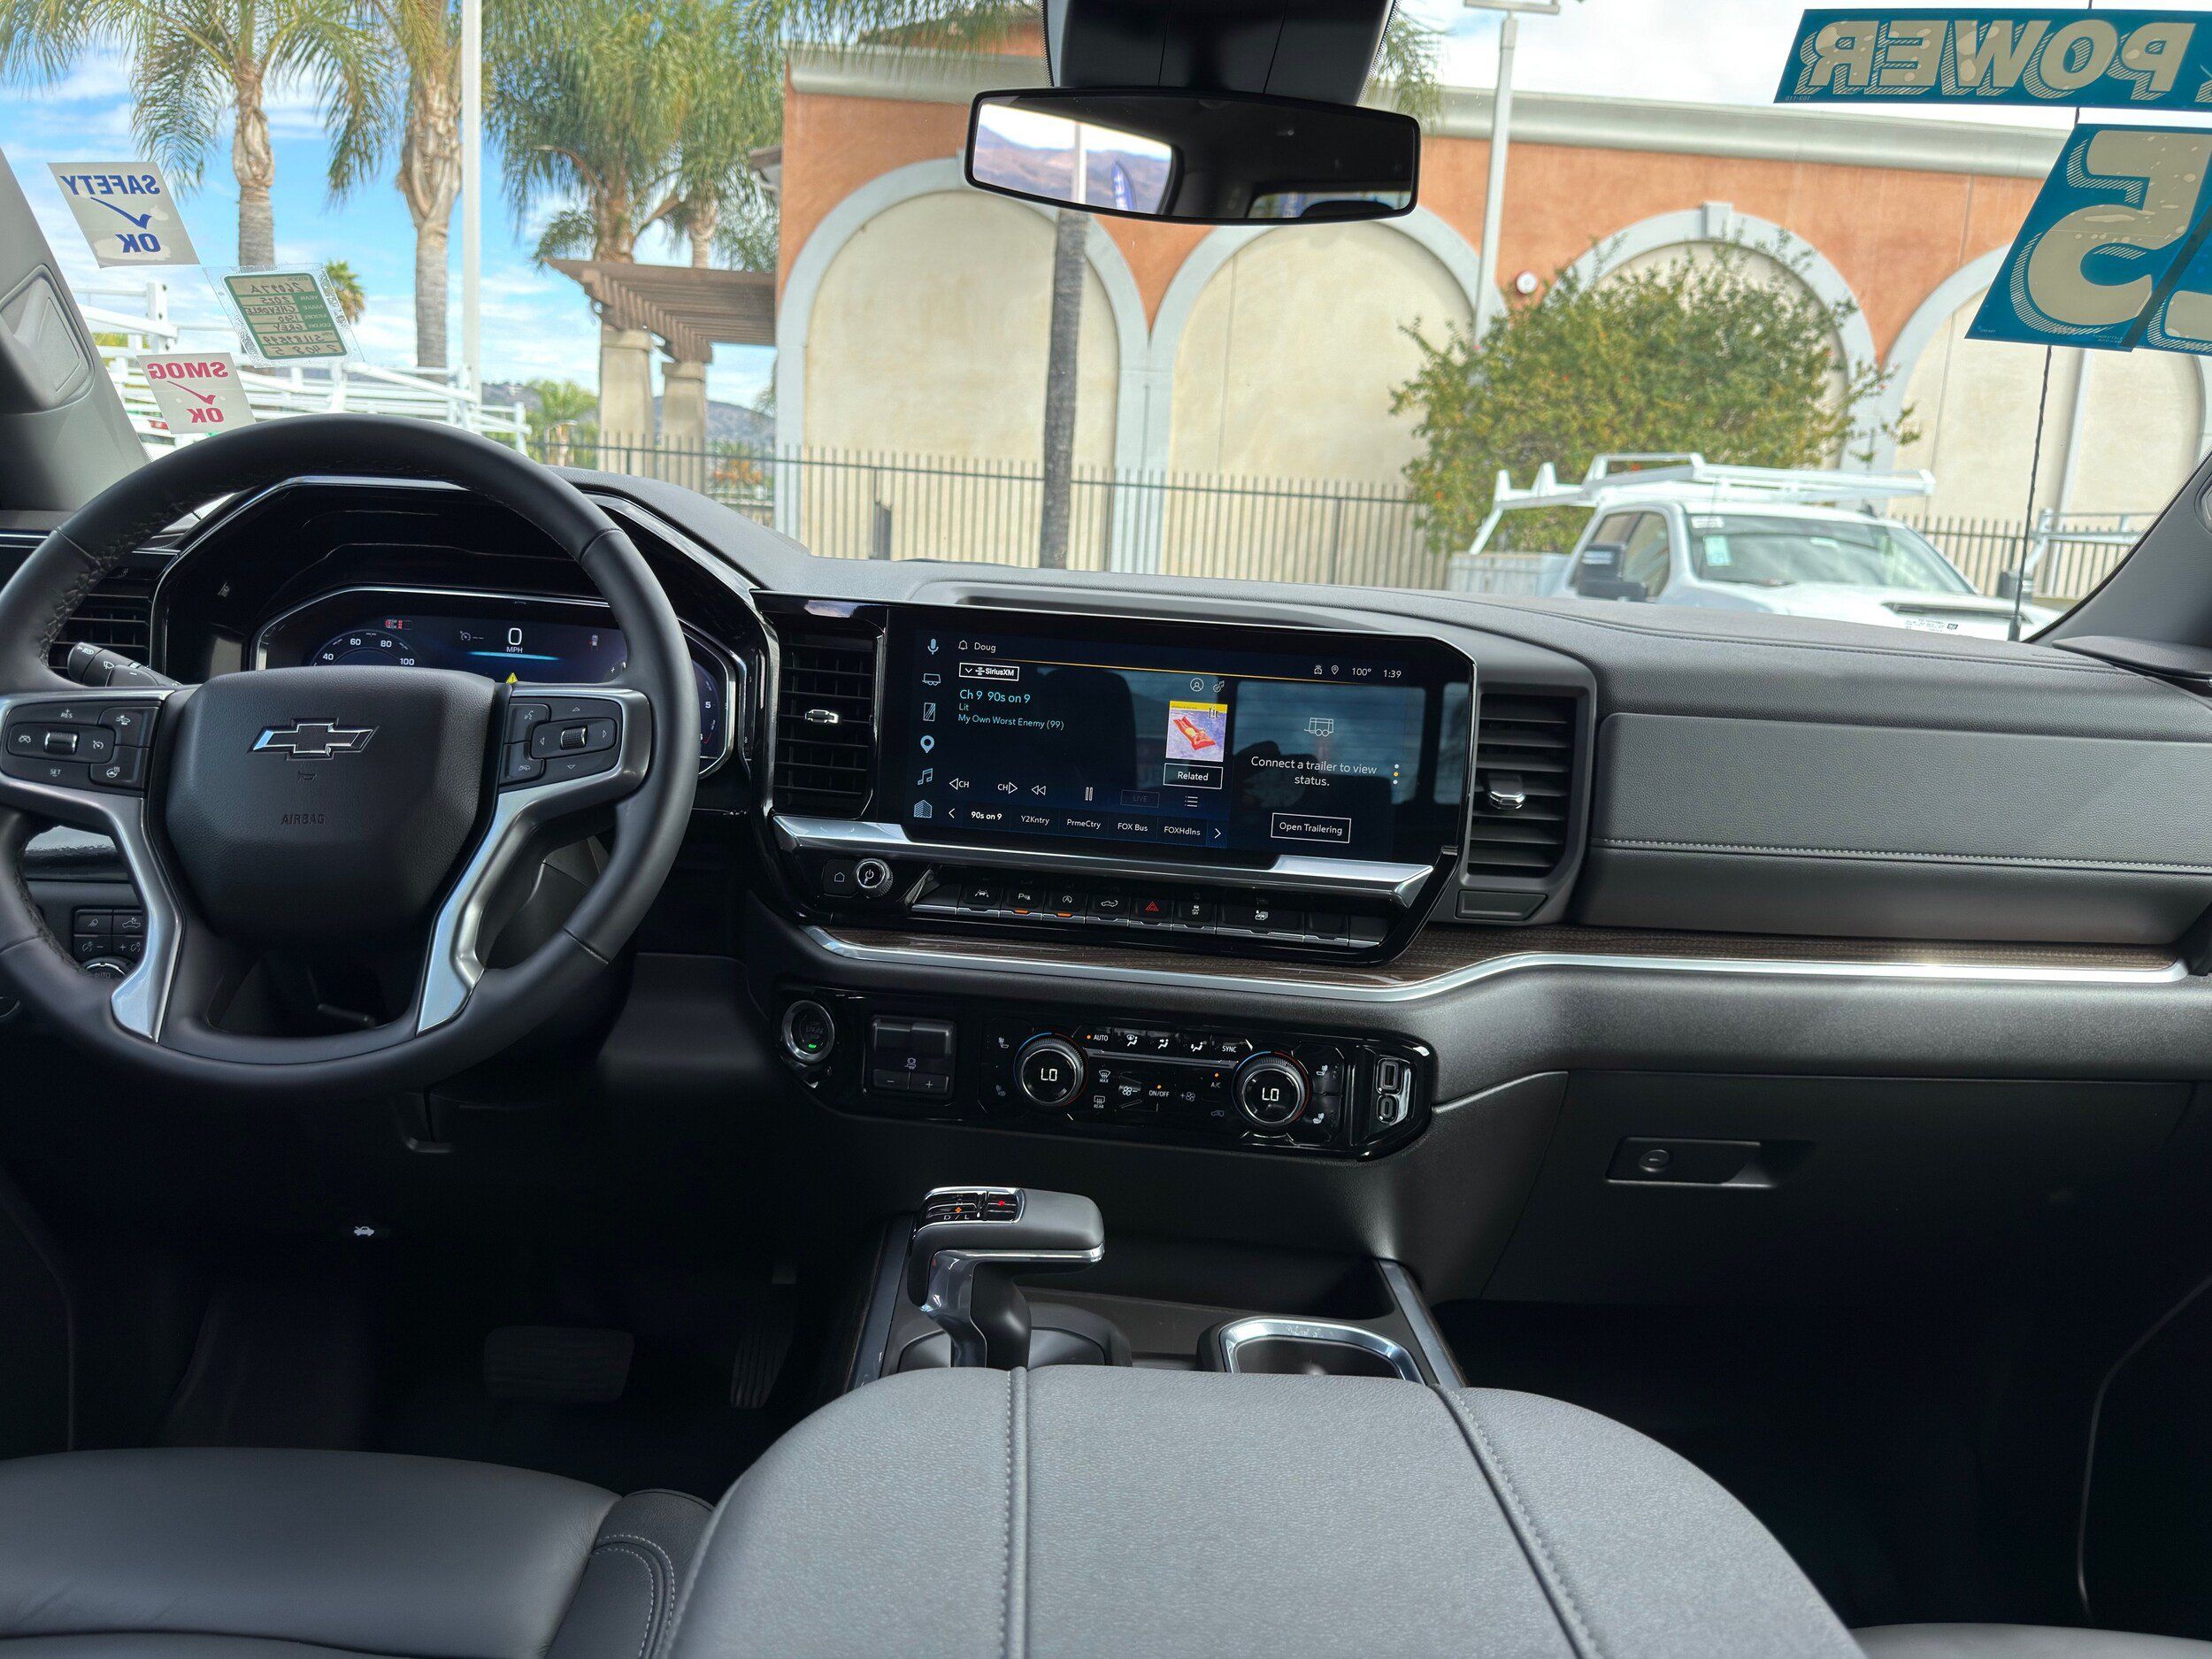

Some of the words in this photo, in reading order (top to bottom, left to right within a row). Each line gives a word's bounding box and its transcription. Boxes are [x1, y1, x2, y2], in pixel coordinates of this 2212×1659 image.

[508, 627, 522, 645] 0
[974, 642, 996, 653] Doug
[985, 668, 1015, 677] SiriusXM
[1383, 668, 1402, 679] 1:39
[959, 689, 973, 700] Ch
[976, 690, 983, 700] 9
[987, 691, 1006, 702] 90s
[1008, 695, 1022, 703] on
[1024, 694, 1031, 703] 9
[958, 714, 971, 724] My
[972, 715, 990, 724] Own
[992, 716, 1016, 726] Worst
[1018, 718, 1045, 729] Enemy
[1046, 720, 1064, 731] (99)
[1251, 756, 1295, 769] Connect
[1297, 761, 1303, 770] a
[1306, 761, 1338, 772] trailer
[1340, 764, 1350, 773] to
[1353, 764, 1378, 774] view
[1178, 772, 1209, 781] Related
[1294, 775, 1330, 787] status.
[280, 813, 325, 826] AIRBAG
[971, 810, 985, 819] 90s
[1020, 815, 1050, 826] Y2Kntry
[1066, 818, 1102, 830] PrmeCtry
[1118, 822, 1133, 831] FOX
[1279, 821, 1302, 832] Open
[1304, 823, 1343, 836] Trailering
